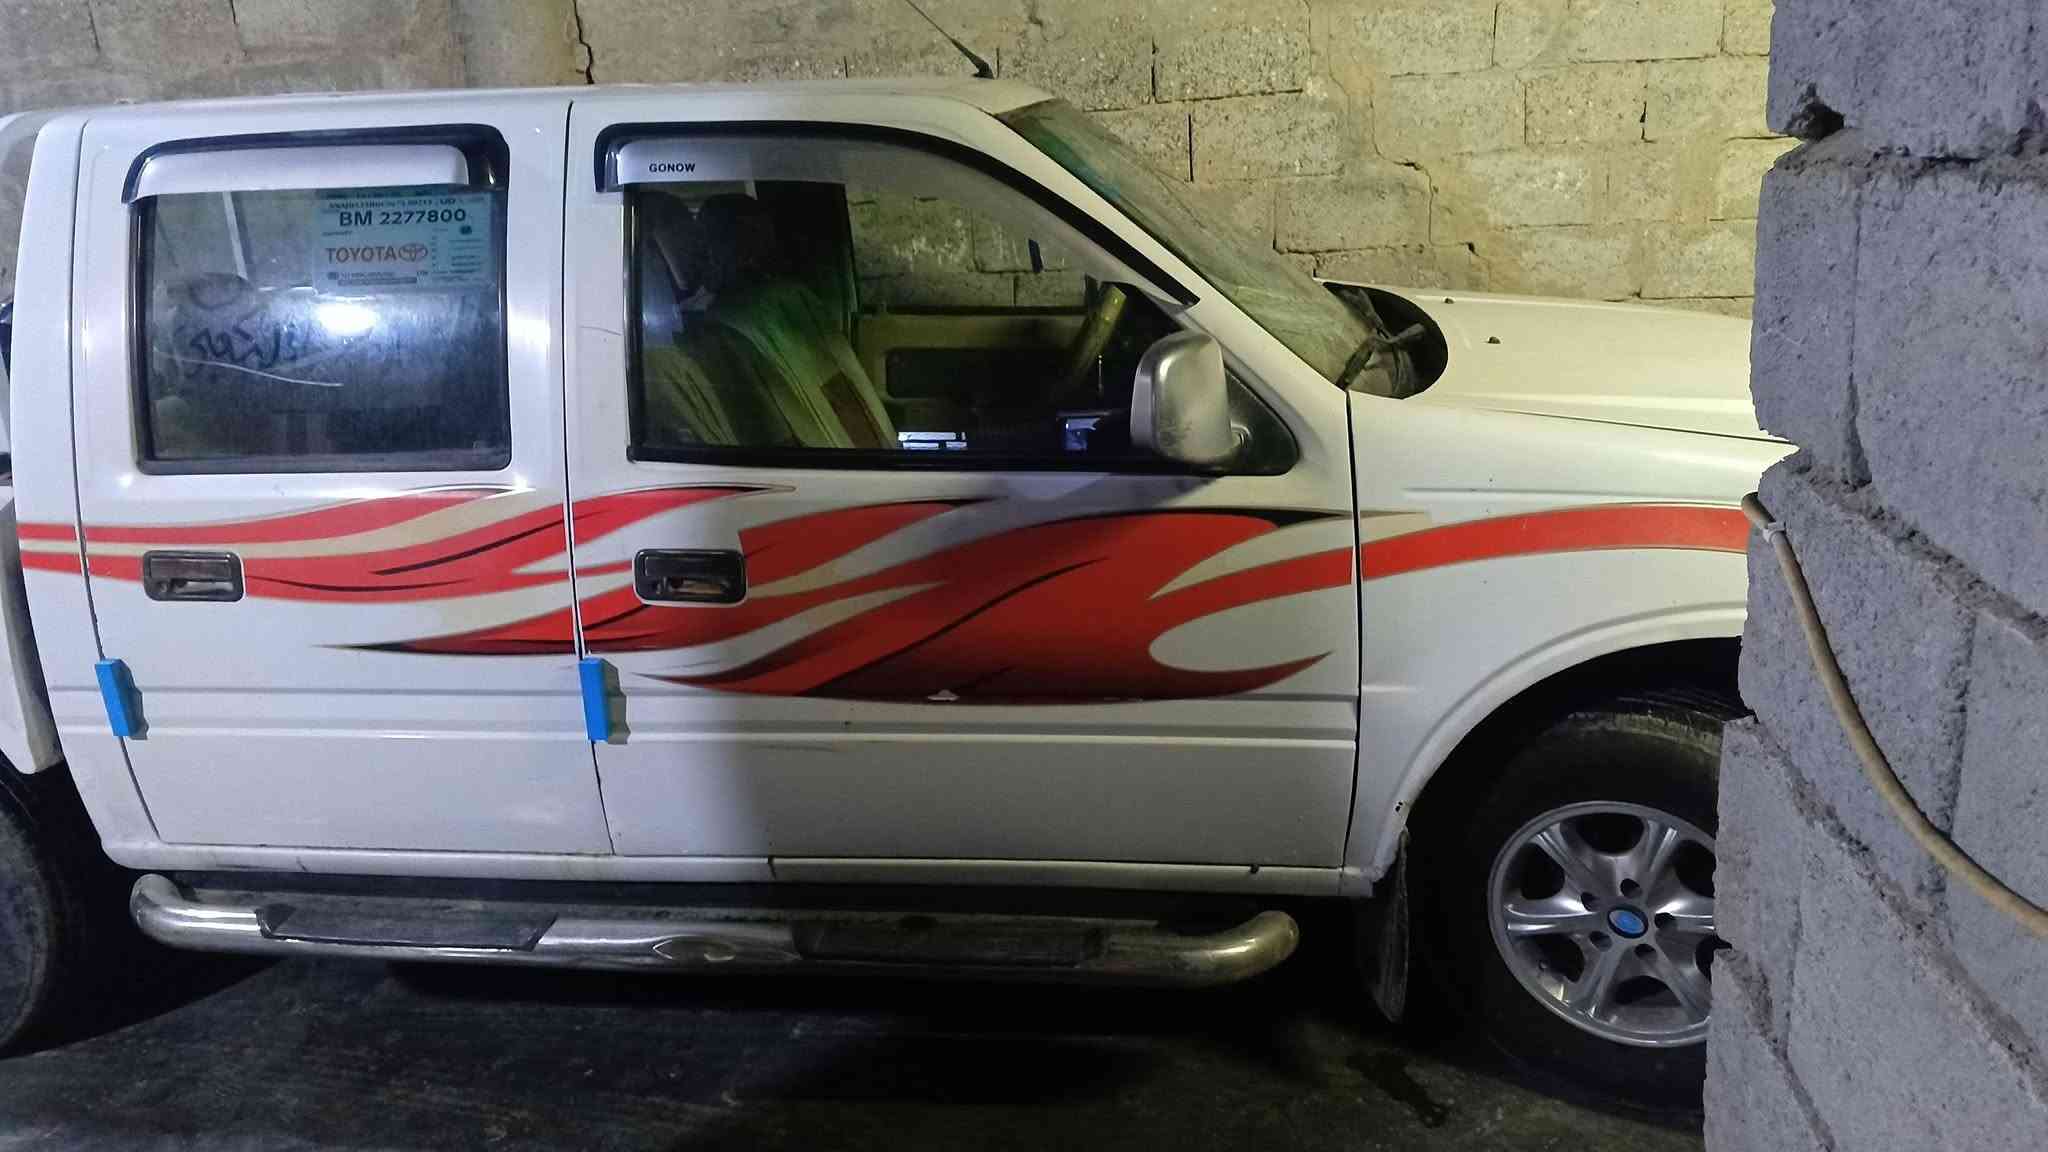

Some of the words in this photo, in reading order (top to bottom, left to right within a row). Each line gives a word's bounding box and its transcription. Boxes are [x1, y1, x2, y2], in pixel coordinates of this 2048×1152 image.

[649, 163, 696, 173] GONOW
[340, 210, 373, 227] BM
[379, 208, 467, 225] 2277800
[325, 245, 397, 264] TOYOTA
